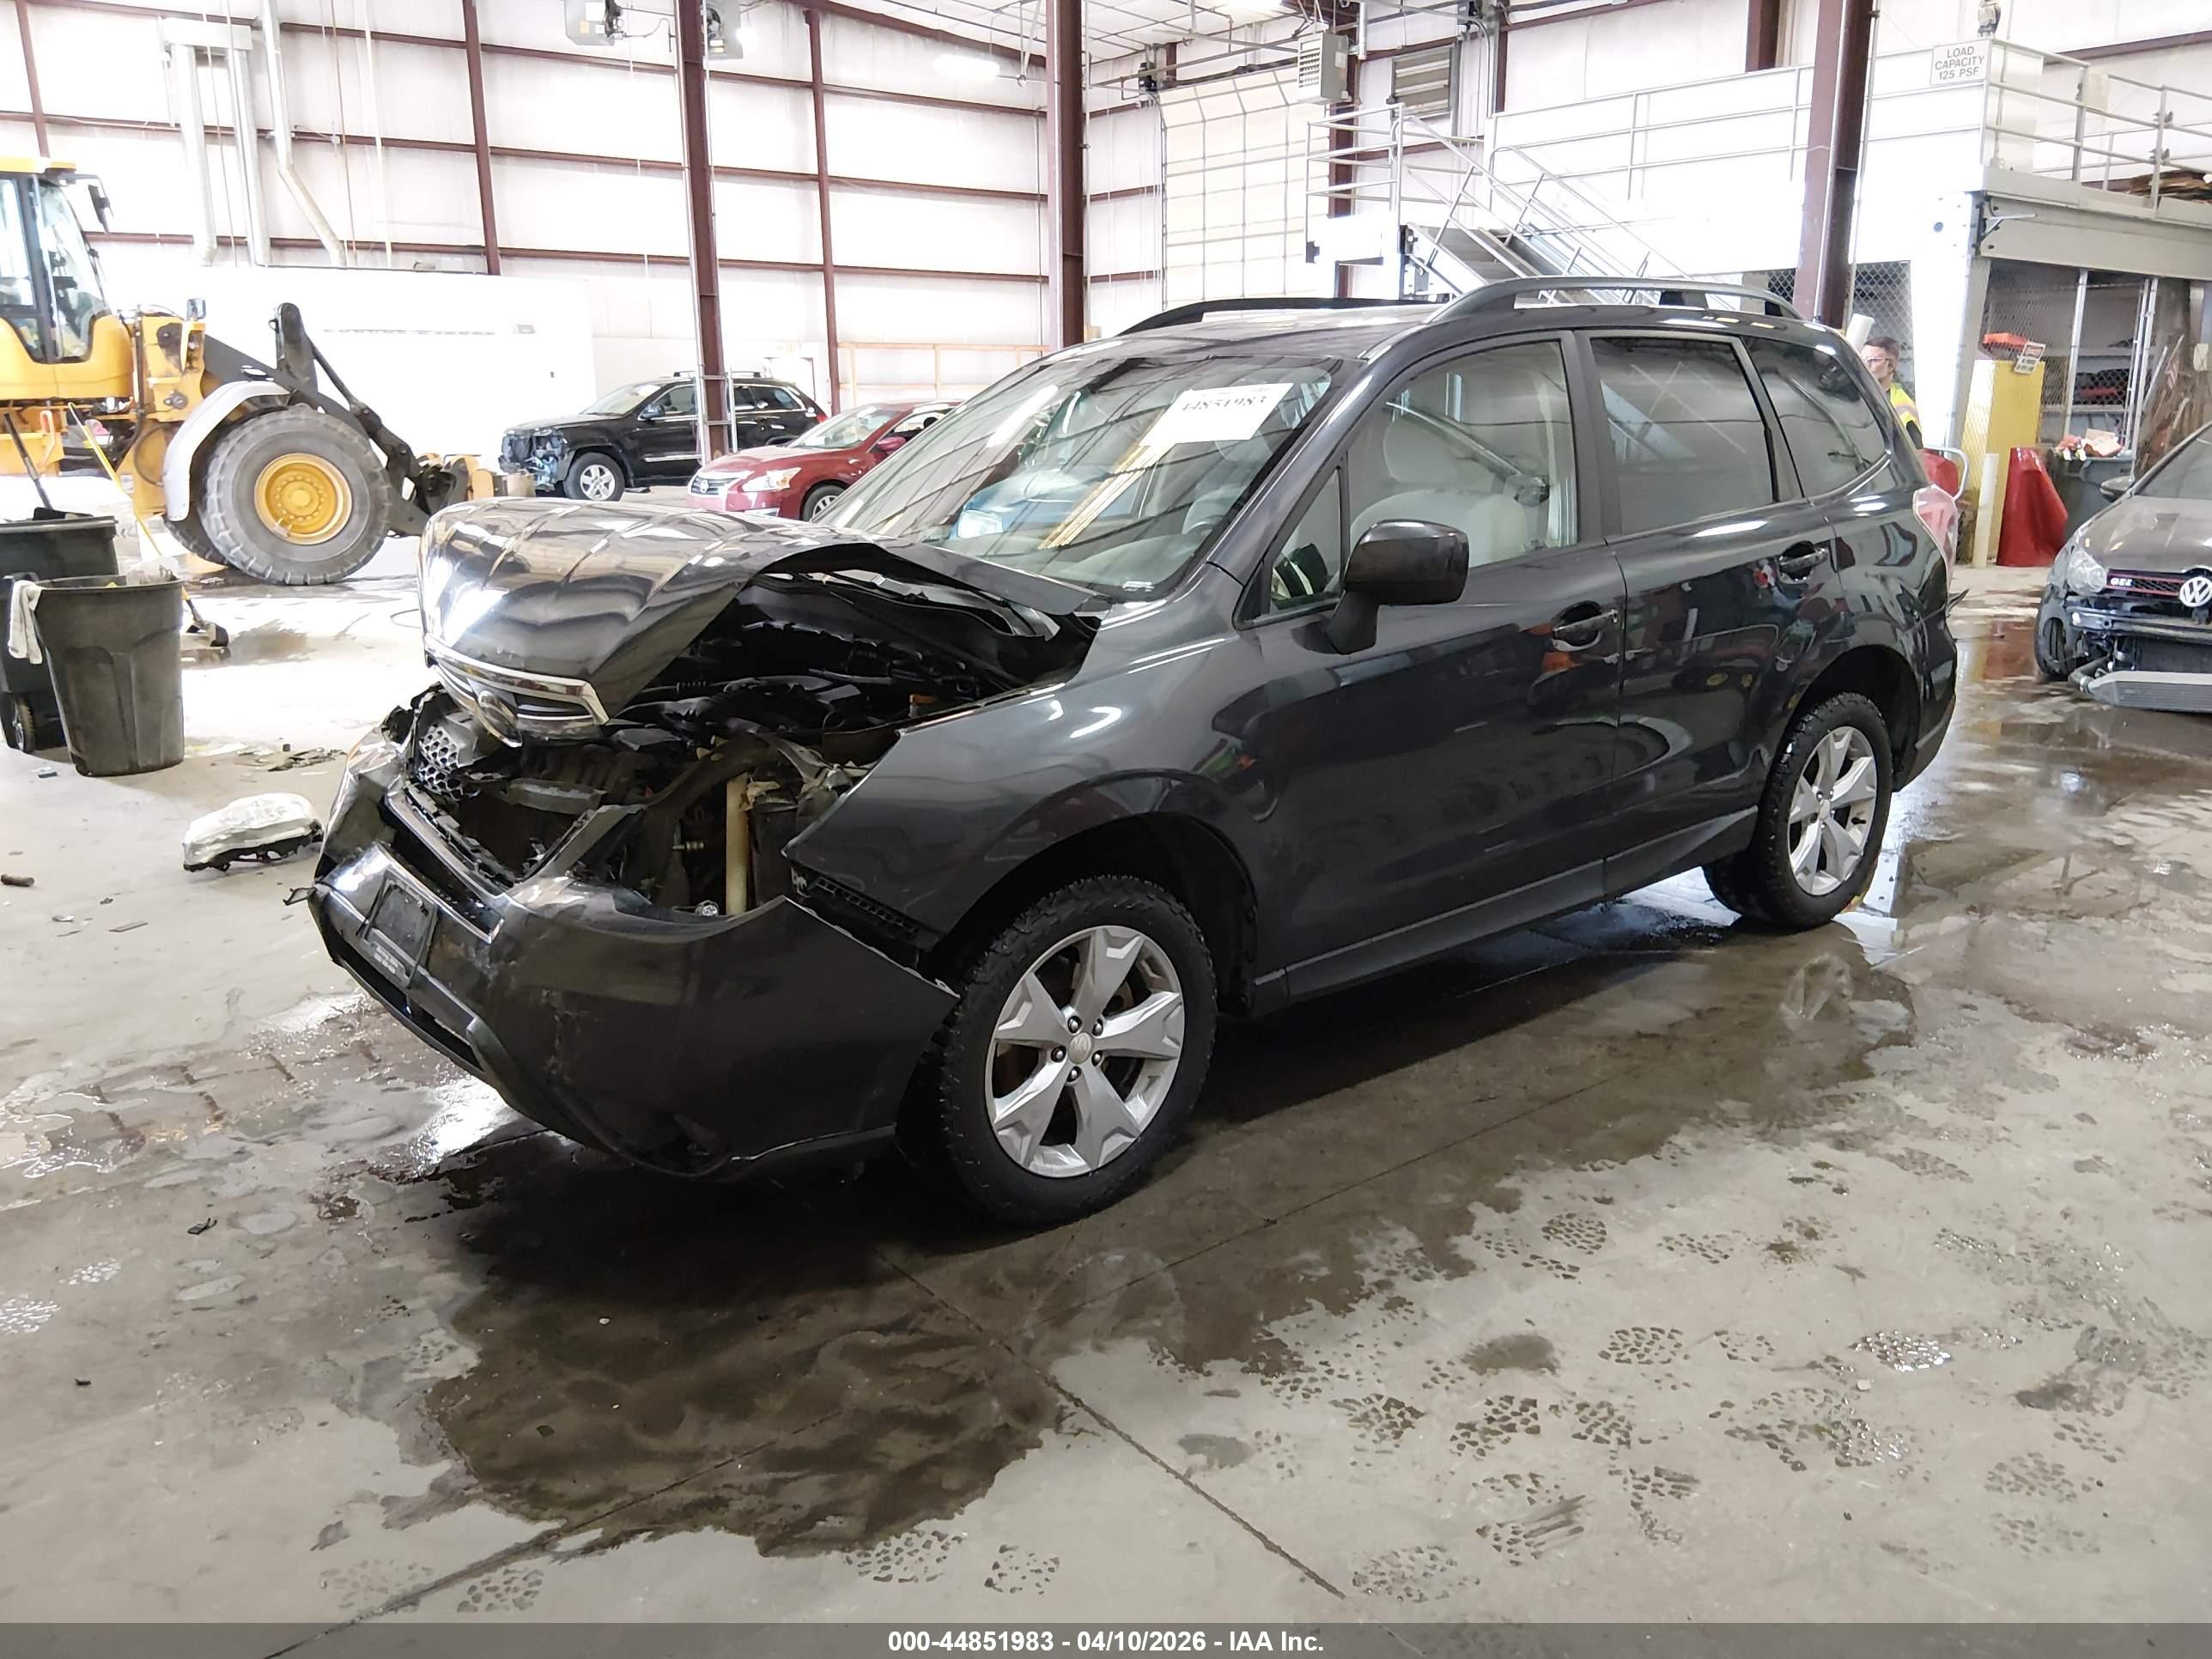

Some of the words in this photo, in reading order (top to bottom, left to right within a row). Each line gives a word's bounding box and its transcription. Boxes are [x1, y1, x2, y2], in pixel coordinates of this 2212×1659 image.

[1947, 46, 1975, 58] LOAD
[1935, 55, 1985, 70] CAPACITY
[1939, 70, 1955, 81] 125
[1959, 66, 1979, 78] PSF
